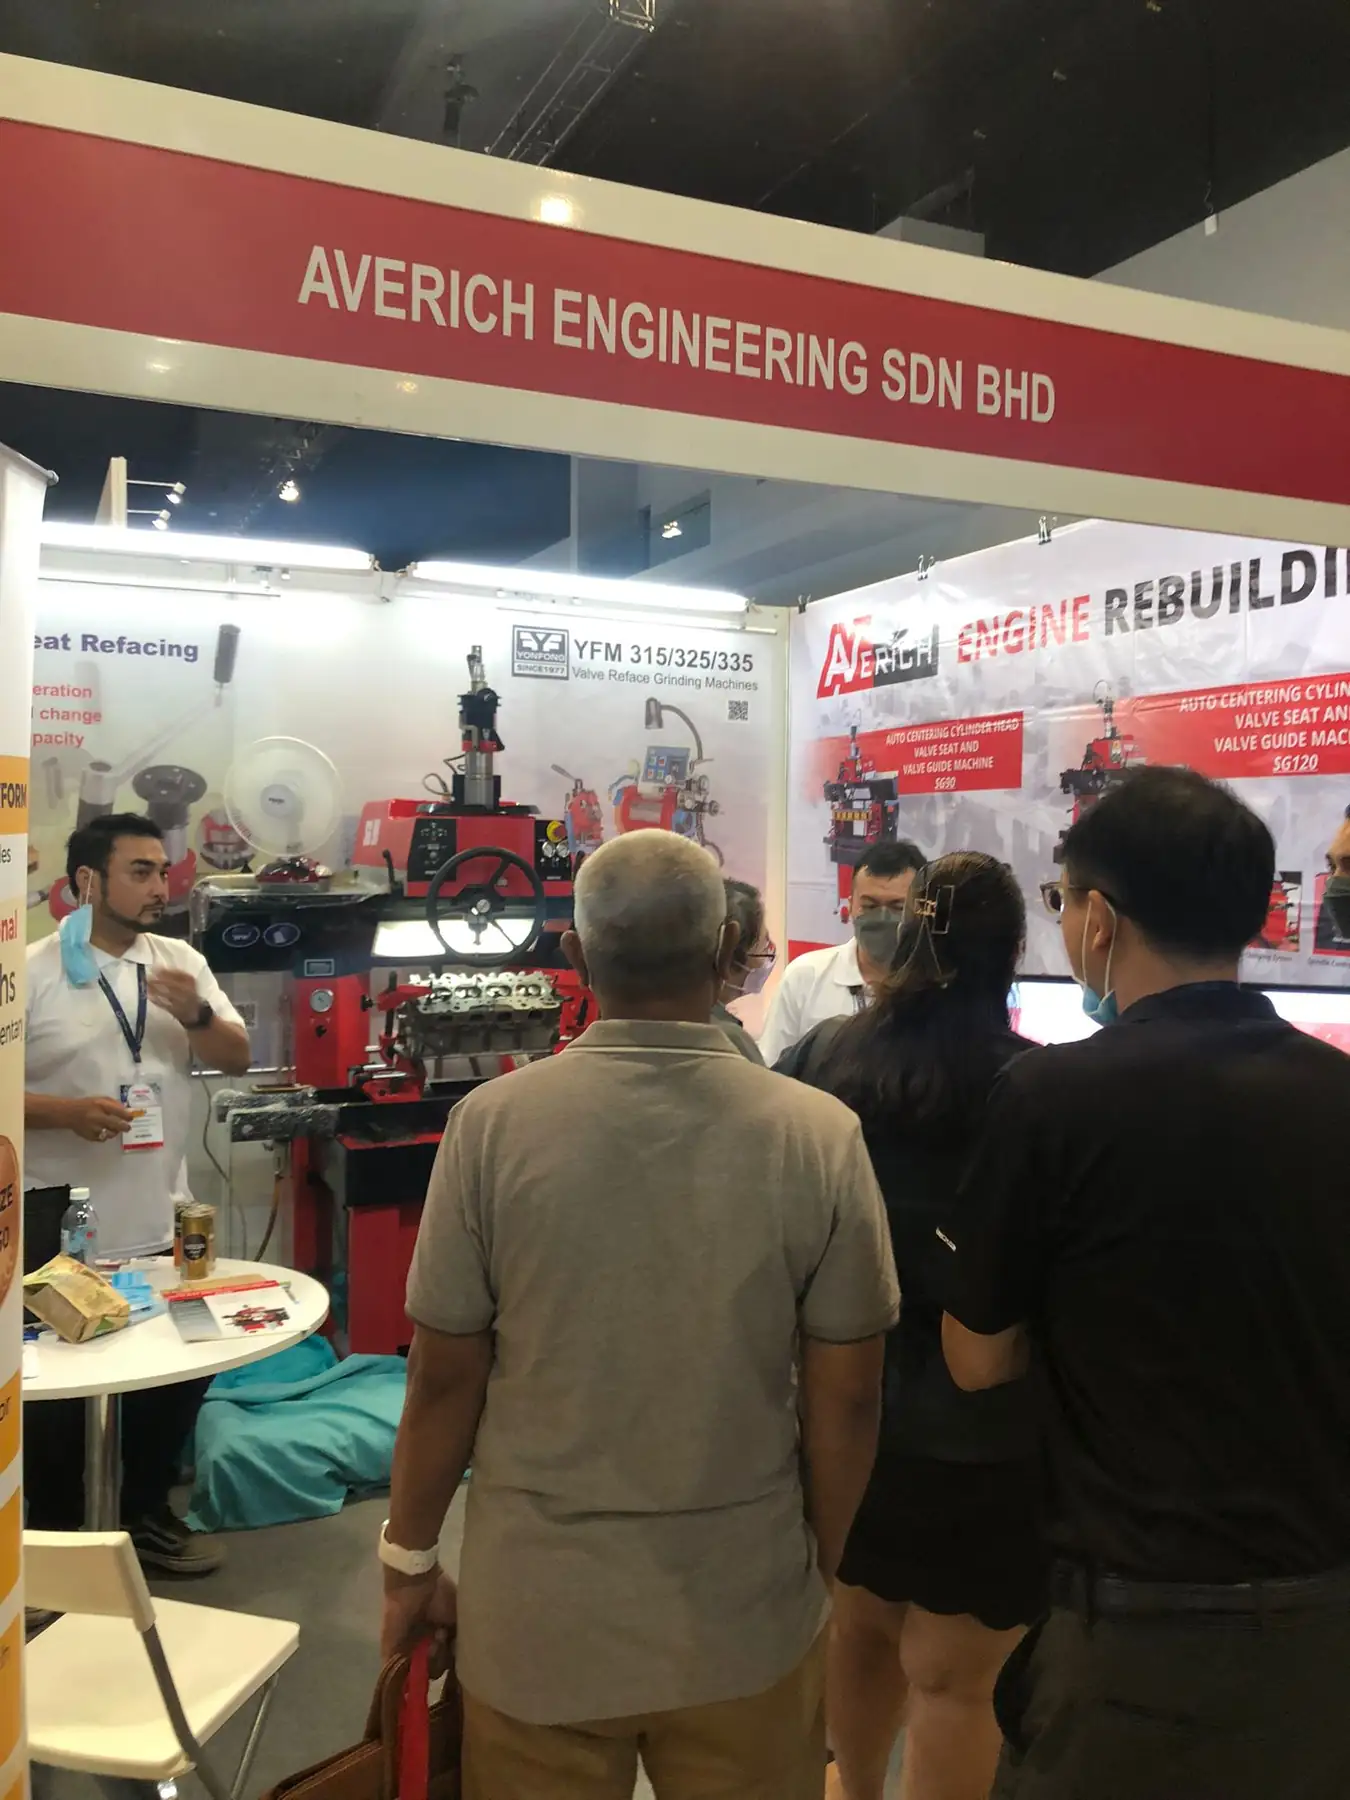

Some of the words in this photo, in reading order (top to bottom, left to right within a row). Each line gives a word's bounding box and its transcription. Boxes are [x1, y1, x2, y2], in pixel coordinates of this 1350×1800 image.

[298, 245, 535, 341] AVERICH
[553, 288, 867, 395] ENGINEERING
[881, 347, 962, 411] SDN
[976, 363, 1055, 423] BHD
[957, 594, 1089, 664] ENGINE
[1104, 546, 1350, 636] REBUILDI
[81, 633, 199, 662] Refacing
[574, 639, 622, 662] YFM
[630, 645, 754, 672] 315/325/335
[32, 684, 92, 698] eration
[572, 666, 605, 681] Valve
[609, 669, 650, 685] Reface
[654, 673, 701, 690] Grinding
[705, 676, 759, 692] Machines
[1179, 695, 1217, 712] AUTO
[1221, 686, 1300, 709] CENTERING
[40, 708, 102, 725] change
[1235, 710, 1280, 729] VALVE
[1284, 707, 1320, 725] SEAT
[1322, 704, 1350, 723] AN
[32, 732, 84, 748] pacity
[885, 733, 906, 746] AUTO
[906, 726, 949, 742] CENTERING
[1213, 735, 1257, 752] VALVE
[1261, 731, 1306, 749] GUIDE
[1311, 727, 1350, 747] MAC
[914, 745, 938, 759] VALVE
[938, 742, 959, 756] SEAT
[959, 740, 980, 753] AND
[902, 762, 926, 775] VALVE
[926, 759, 953, 773] GUIDE
[953, 755, 995, 772] MACHINE
[1272, 753, 1319, 773] SG120
